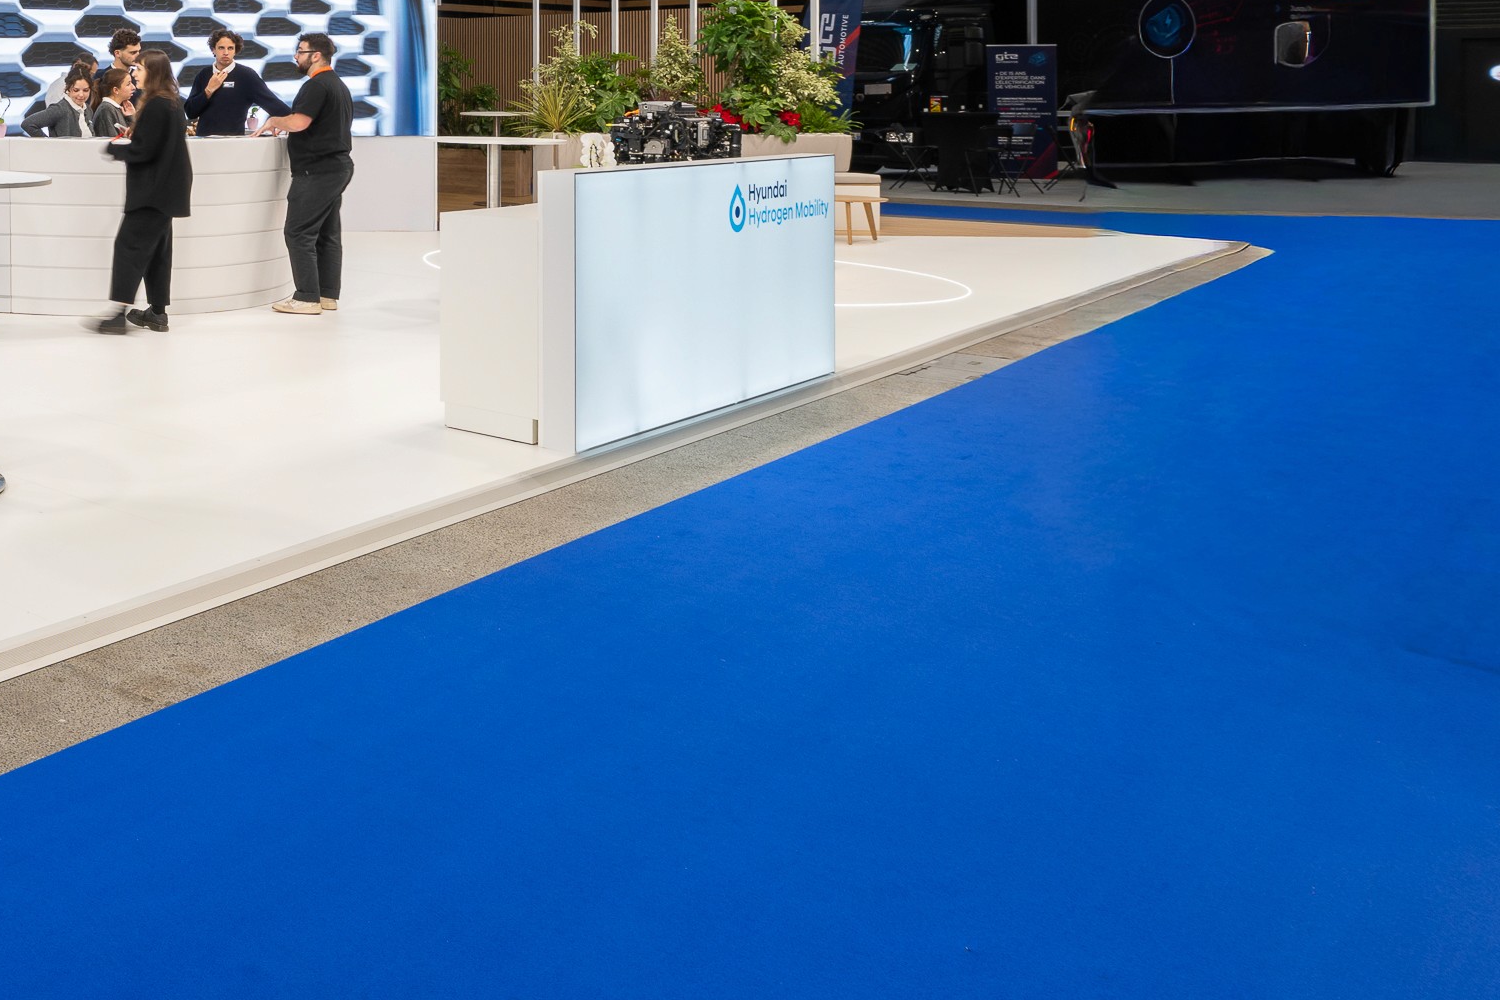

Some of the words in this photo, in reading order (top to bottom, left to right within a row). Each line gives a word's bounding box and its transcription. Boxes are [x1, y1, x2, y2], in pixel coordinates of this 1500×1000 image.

[838, 14, 850, 65] AUTOMOTIVE
[748, 179, 788, 204] Hyundai
[748, 206, 794, 228] Hydrogen
[795, 198, 829, 219] Mobility
